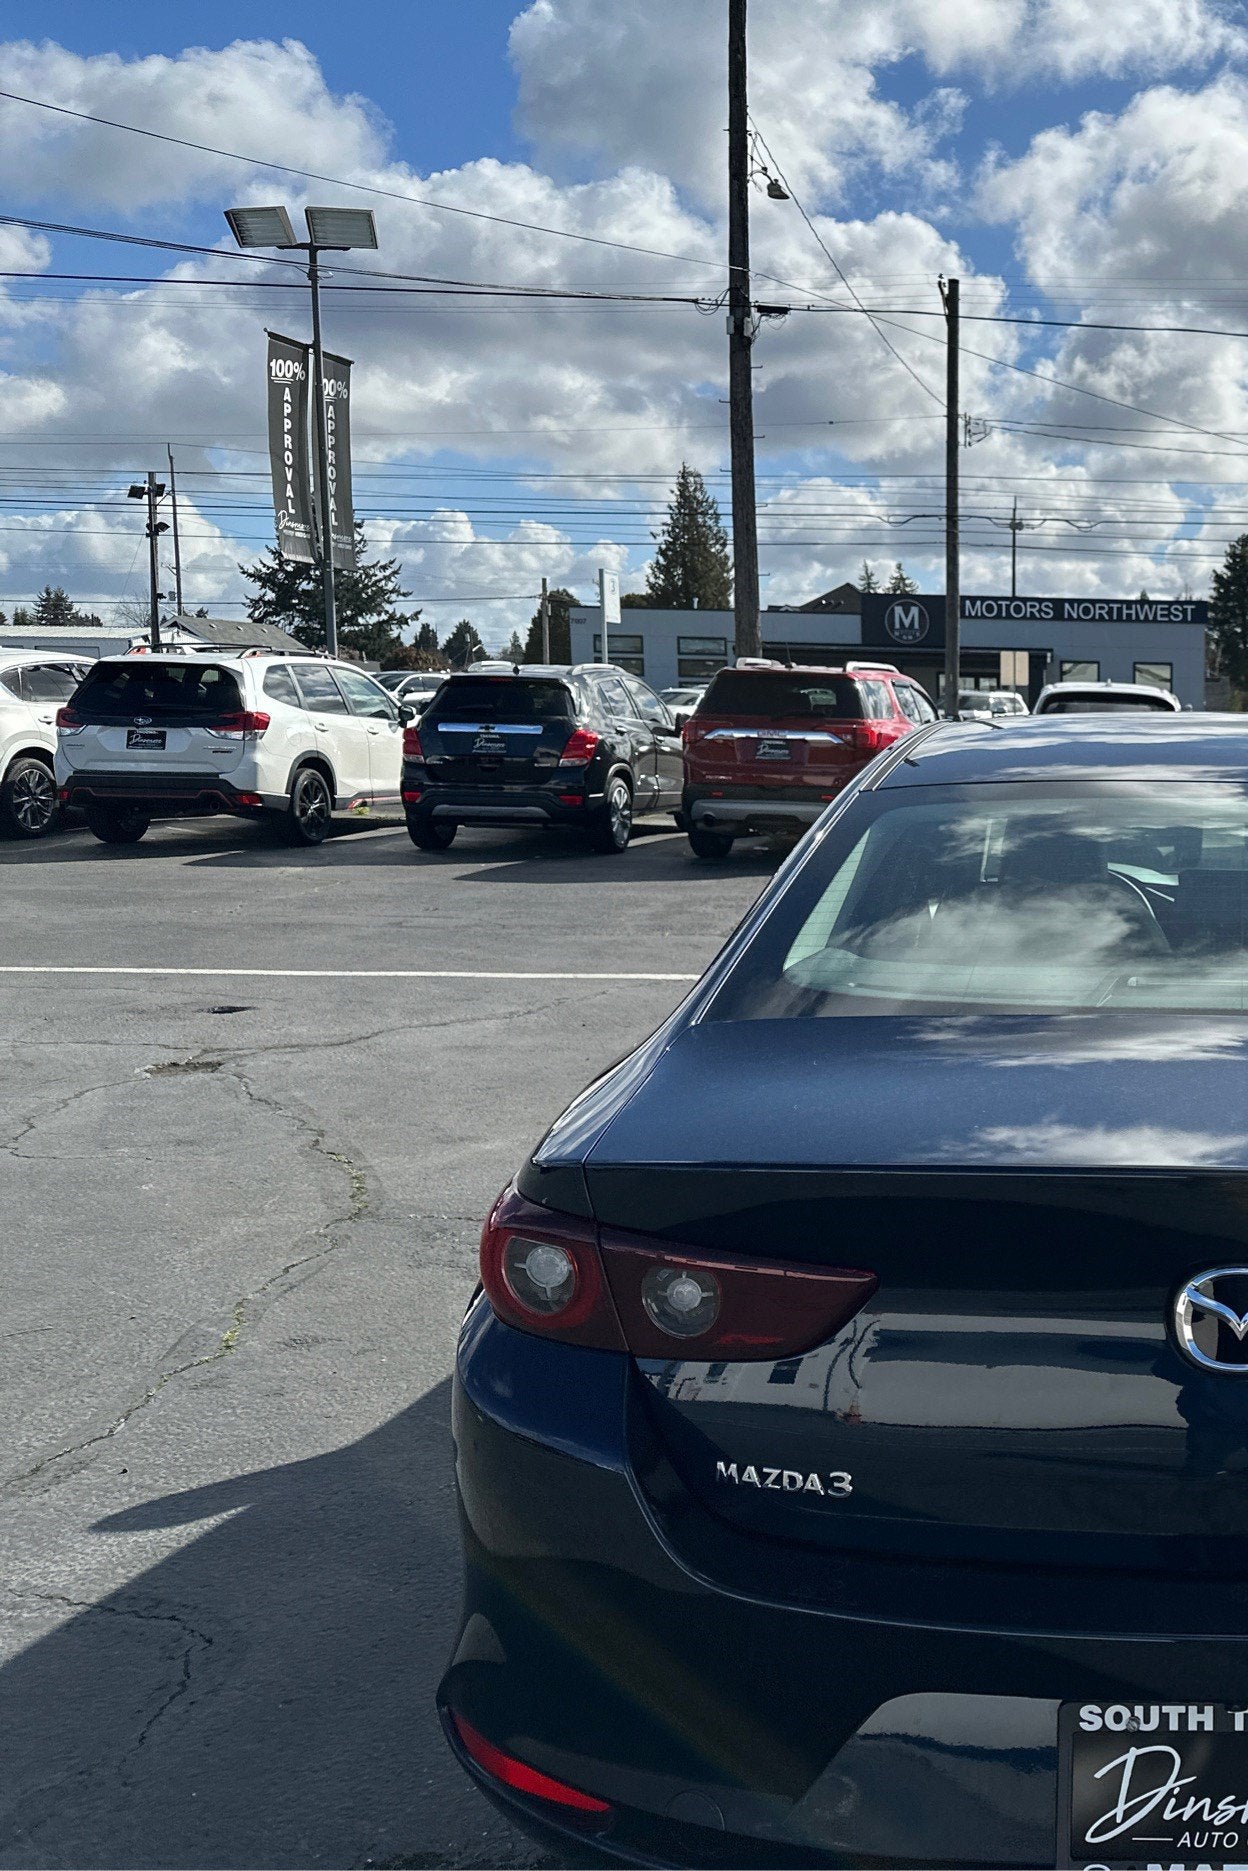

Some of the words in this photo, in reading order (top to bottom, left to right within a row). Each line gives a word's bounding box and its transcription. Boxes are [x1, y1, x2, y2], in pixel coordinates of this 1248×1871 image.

[270, 358, 306, 381] 100%
[322, 378, 349, 399] 00%
[283, 387, 296, 514] APPROVAL
[327, 405, 339, 526] APPROVAL
[894, 605, 919, 629] M
[965, 600, 1054, 618] MOTORS
[1064, 602, 1196, 621] NORTHWEST
[716, 1461, 854, 1499] MAZDA3
[1079, 1704, 1214, 1732] SOUTH
[1176, 1831, 1239, 1849] AUTO
